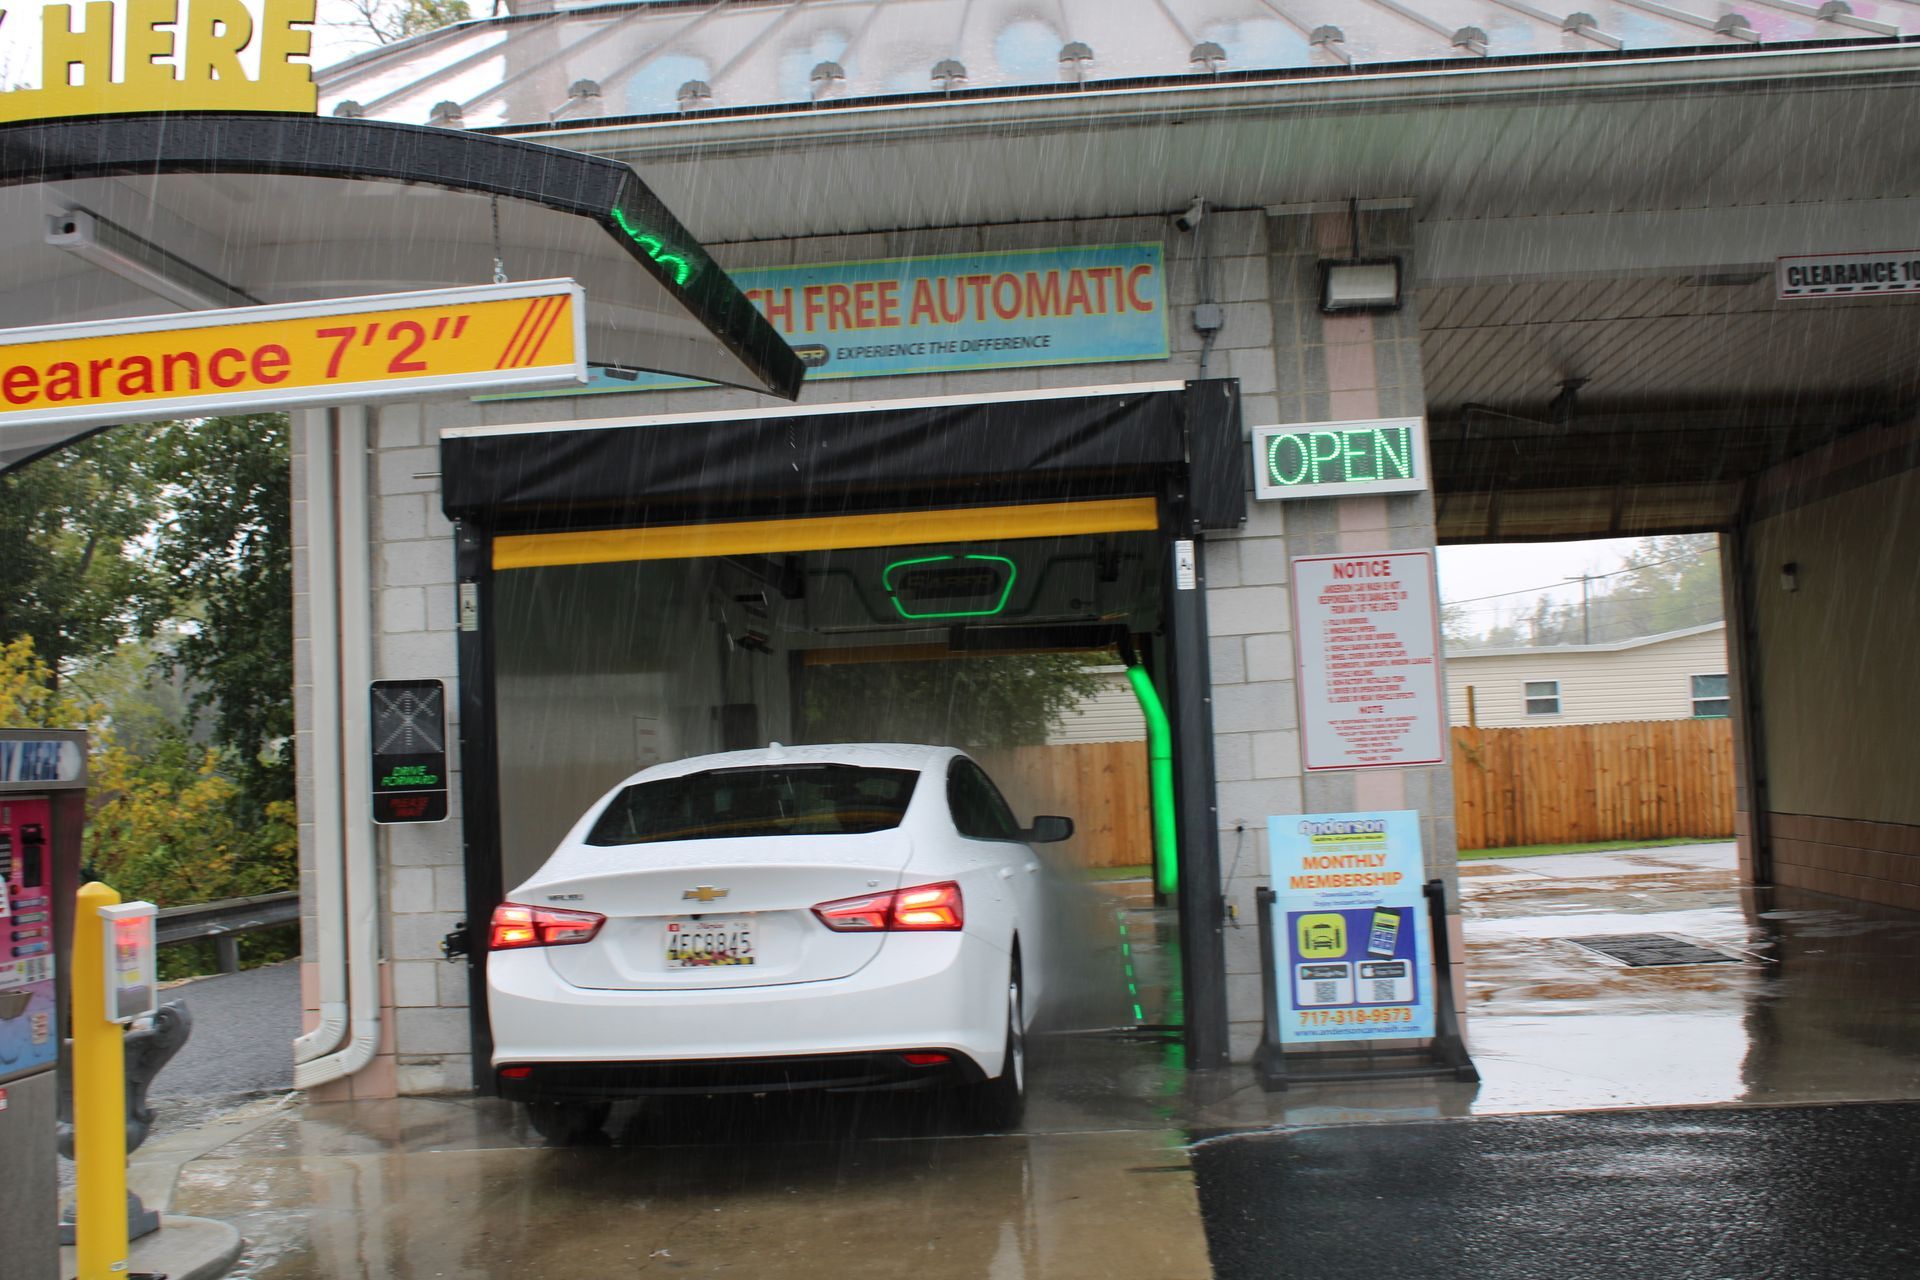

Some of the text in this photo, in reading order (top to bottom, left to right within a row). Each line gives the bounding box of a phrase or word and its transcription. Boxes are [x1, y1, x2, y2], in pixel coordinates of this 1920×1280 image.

[41, 0, 315, 92] HERE
[1788, 262, 1897, 287] CLEARANCE
[803, 280, 901, 332] FREE
[909, 264, 1153, 325] AUTOMATIC
[836, 343, 925, 360] EXPERIENCE
[929, 341, 959, 355] THE
[960, 335, 1051, 352] DIFFERENCE
[1268, 426, 1410, 485] OPEN
[1332, 560, 1392, 579] NOTICE
[381, 775, 438, 786] FORWARD
[392, 765, 428, 777] DRIVE
[1299, 818, 1388, 835] Anderson
[1303, 854, 1387, 870] MONTHLY
[1289, 872, 1403, 889] MEMBERSHIP
